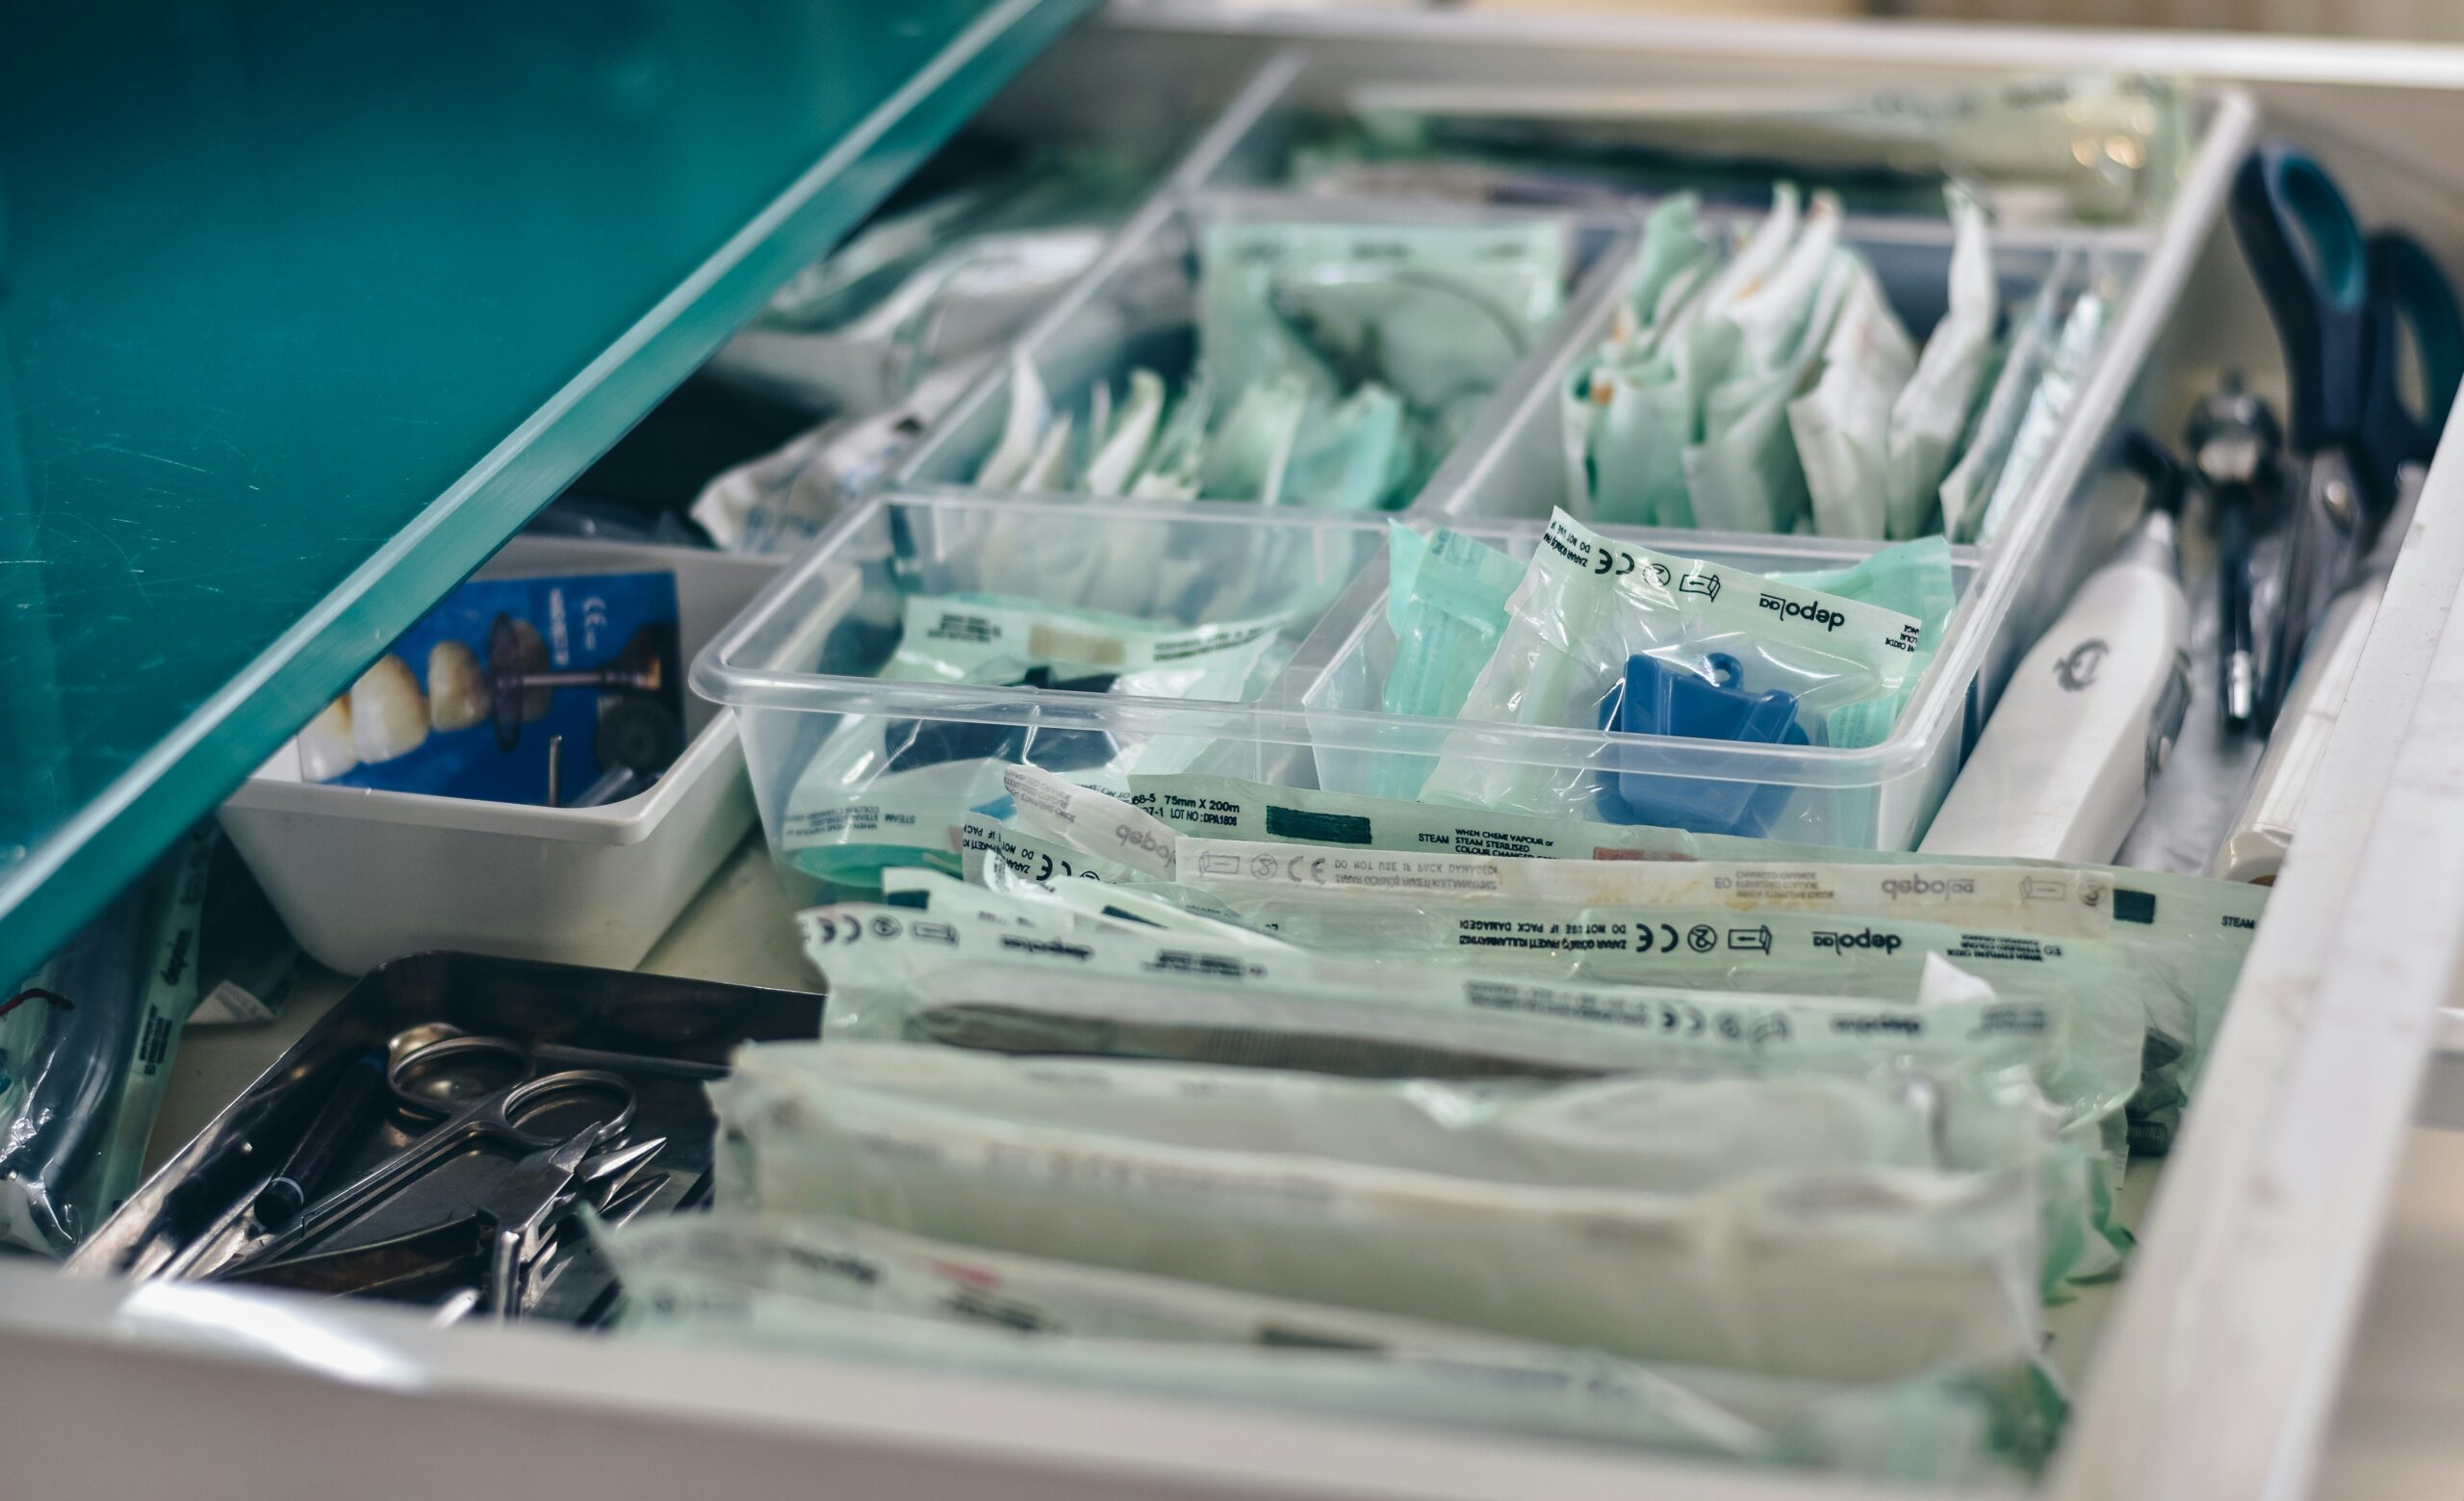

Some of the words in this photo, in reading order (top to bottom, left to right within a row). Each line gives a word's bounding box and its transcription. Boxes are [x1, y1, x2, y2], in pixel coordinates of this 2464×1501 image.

[1579, 541, 1591, 554] DO
[1164, 794, 1196, 808] 75mm
[1199, 798, 1207, 810] X
[1209, 800, 1240, 813] 200m
[1170, 809, 1184, 819] LOT
[1186, 811, 1198, 821] NO
[1419, 833, 1449, 844] STEAM
[1455, 828, 1479, 838] WHEN
[1510, 834, 1543, 845] VAPOUR
[1455, 837, 1482, 846] STEAM
[1021, 848, 1035, 860] DO
[1455, 845, 1491, 856] COLOUR
[1517, 922, 1544, 934] PACK
[1550, 923, 1559, 934] IF
[2220, 915, 2255, 930] STEAM
[1586, 923, 1606, 935] NOT
[1611, 923, 1627, 935] DO
[1597, 939, 1627, 950] ZARAR
